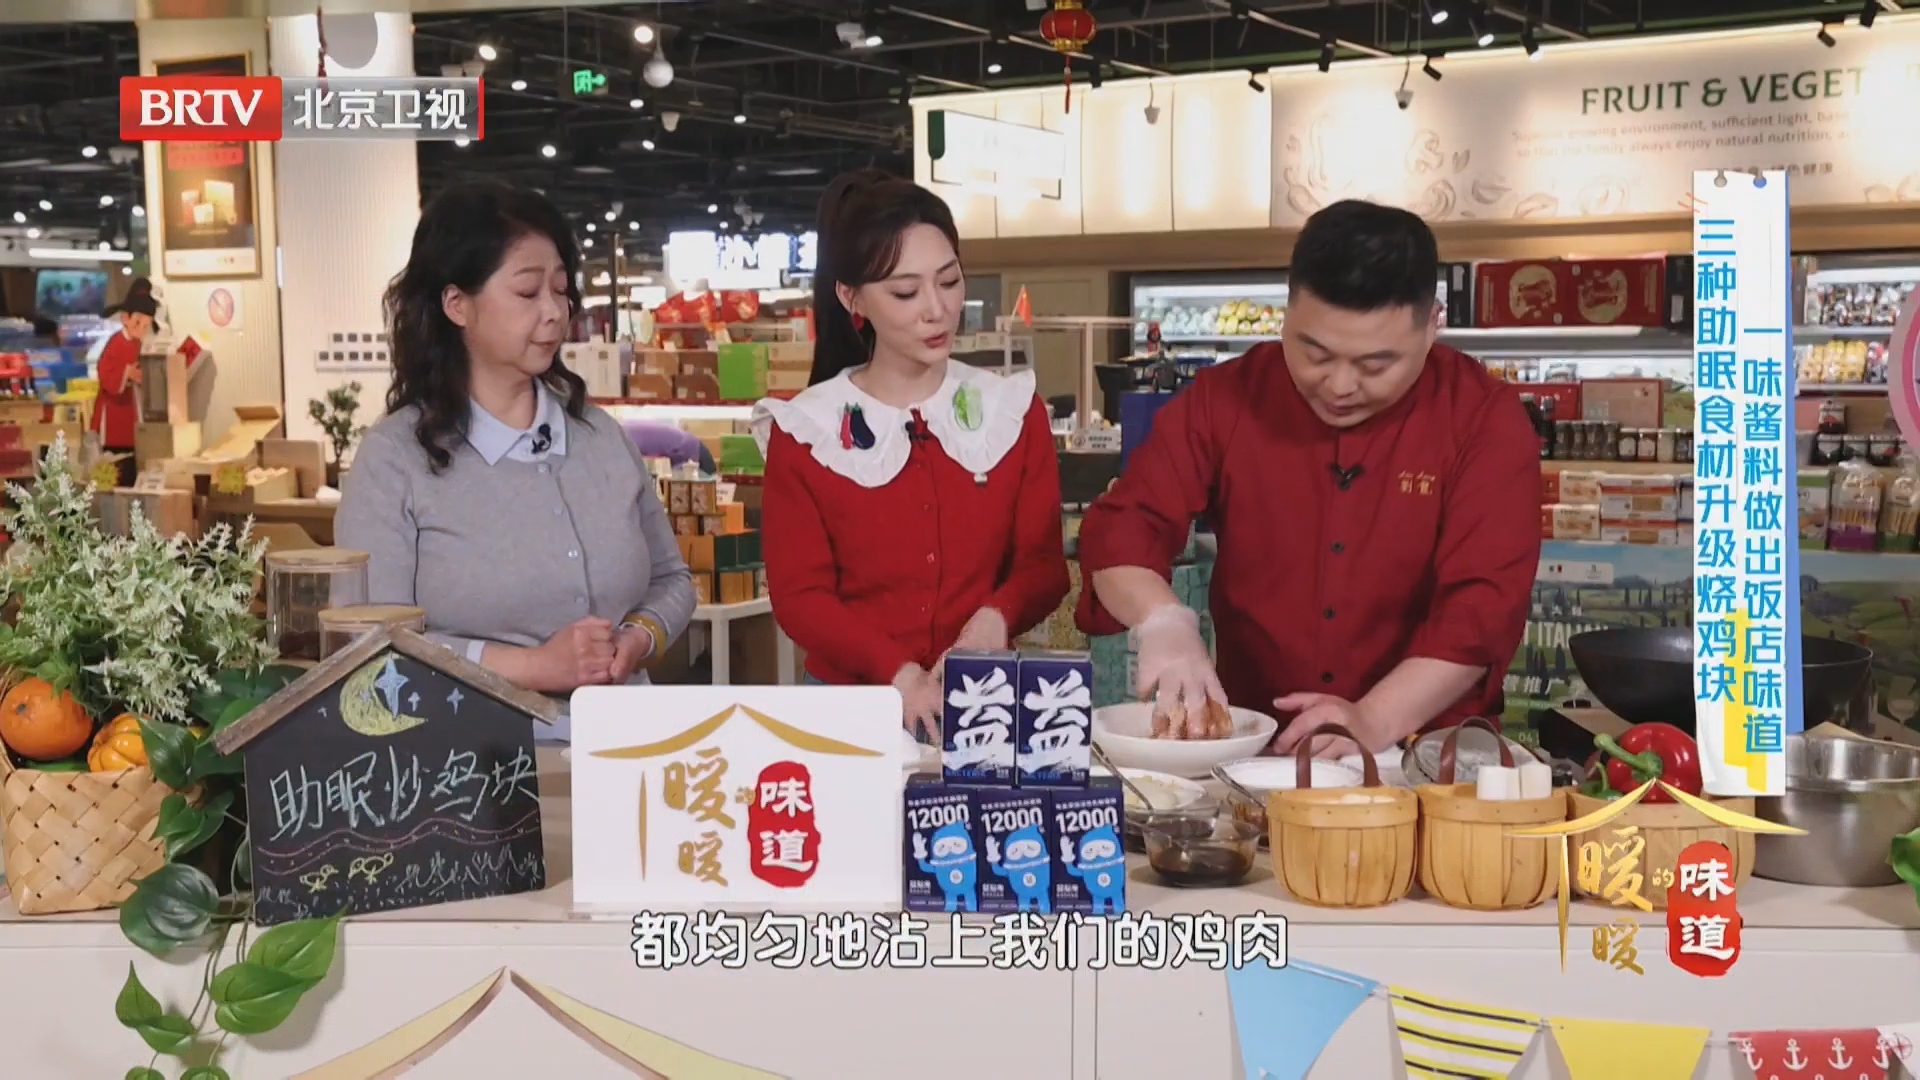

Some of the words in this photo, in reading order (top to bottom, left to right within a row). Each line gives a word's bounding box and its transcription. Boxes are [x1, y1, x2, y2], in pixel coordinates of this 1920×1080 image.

[1581, 80, 1690, 115] FRUIT
[1702, 77, 1727, 107] &
[1740, 67, 1865, 104] VEGET
[1711, 113, 1773, 129] sufficient
[1777, 111, 1813, 127] light,
[1675, 136, 1712, 152] enjoy
[1715, 131, 1764, 147] natural
[1768, 128, 1833, 145] nutrition,
[663, 746, 736, 887] 暖暖
[759, 776, 814, 873] 味道
[907, 804, 970, 830] 12000
[981, 807, 1043, 835] 12000
[1056, 807, 1118, 834] 12000
